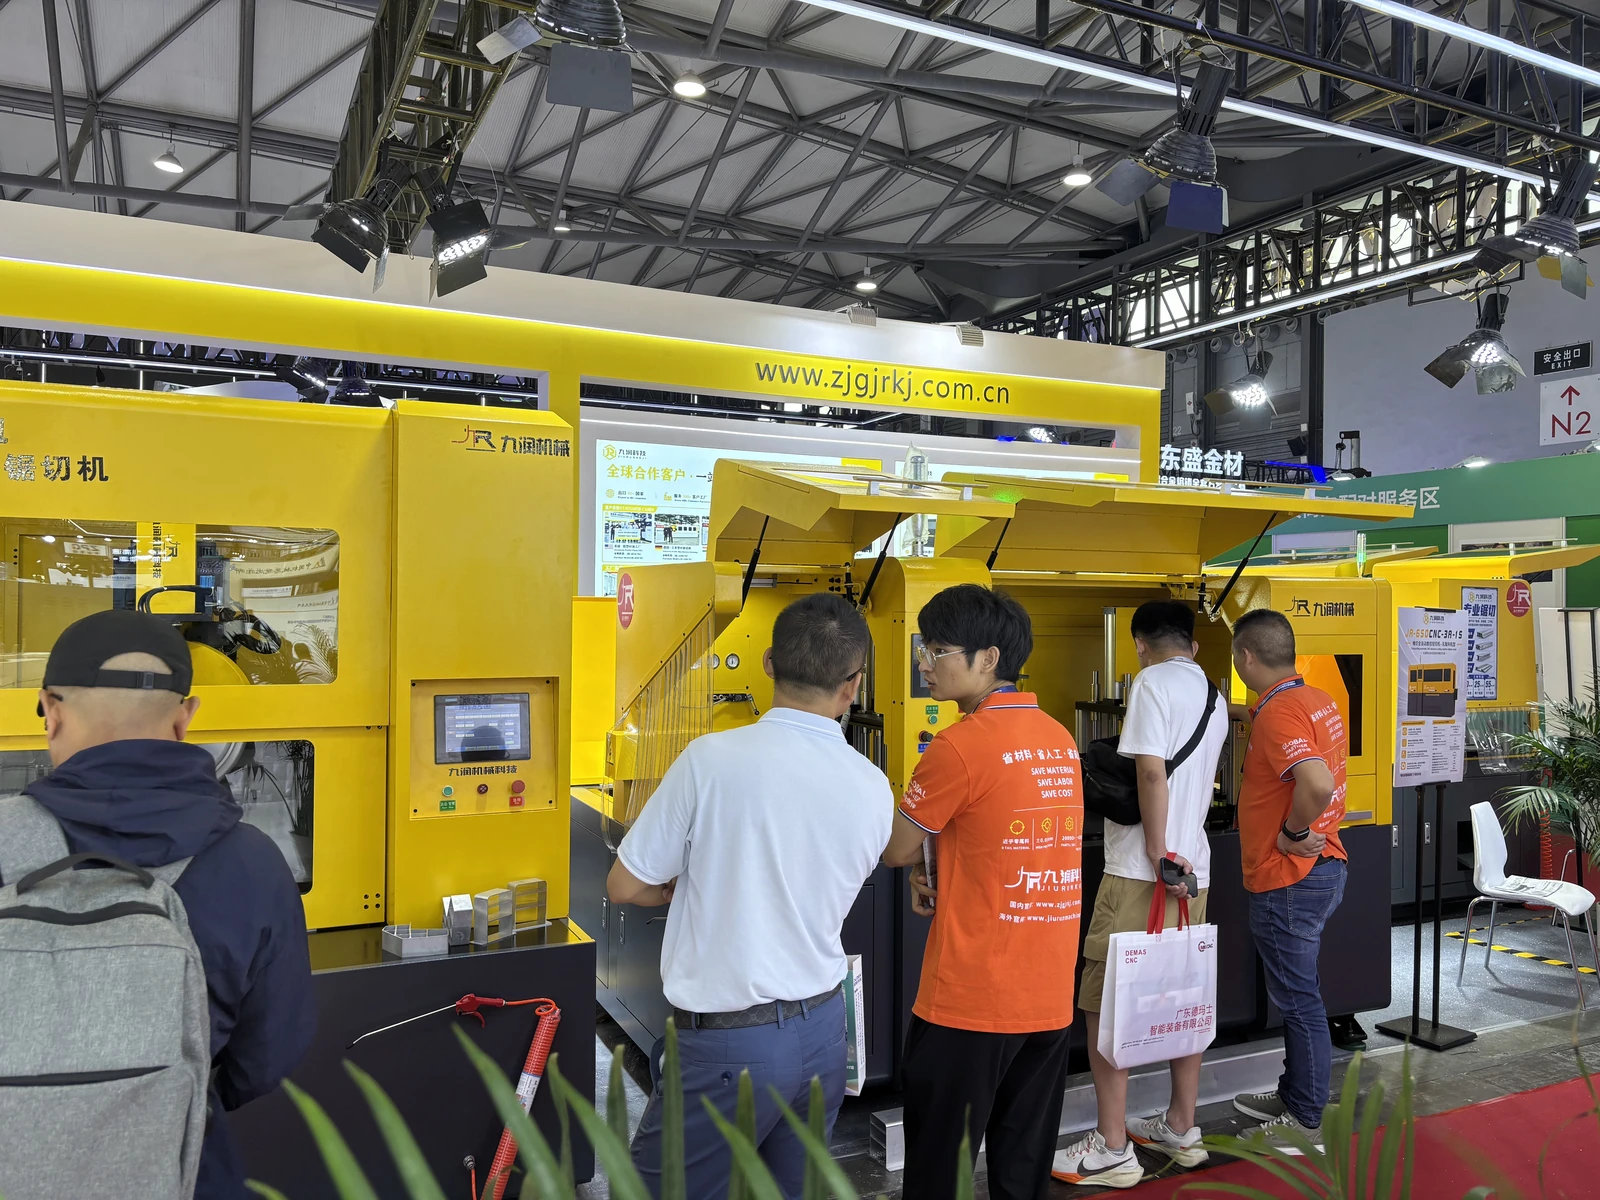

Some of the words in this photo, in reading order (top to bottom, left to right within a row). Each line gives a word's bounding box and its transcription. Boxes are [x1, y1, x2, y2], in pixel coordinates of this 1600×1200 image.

[1543, 348, 1580, 363] 安全出口
[1551, 360, 1572, 370] EXIT
[755, 362, 1010, 404] www.zjgjrkj.com.cn
[1551, 411, 1591, 438] N2
[501, 435, 570, 457] 九润机械
[1160, 443, 1244, 477] 东盛金材
[607, 463, 686, 482] 全球合作客户
[1313, 602, 1355, 617] 九润机械
[1463, 603, 1496, 617] 专业锯切
[1282, 737, 1308, 750] GLOBAL
[448, 765, 517, 777] 九润机械科技
[1031, 767, 1046, 775] SAVE
[1046, 766, 1075, 775] MATERIAL
[1037, 778, 1053, 787] SAVE
[1054, 777, 1074, 786] LABOR
[1041, 789, 1058, 798] SAVE
[1058, 789, 1073, 797] COST
[1125, 948, 1147, 957] DEMAS
[1175, 1003, 1213, 1020] 广东德玛士
[1150, 1015, 1212, 1037] 智能装备有限公司
